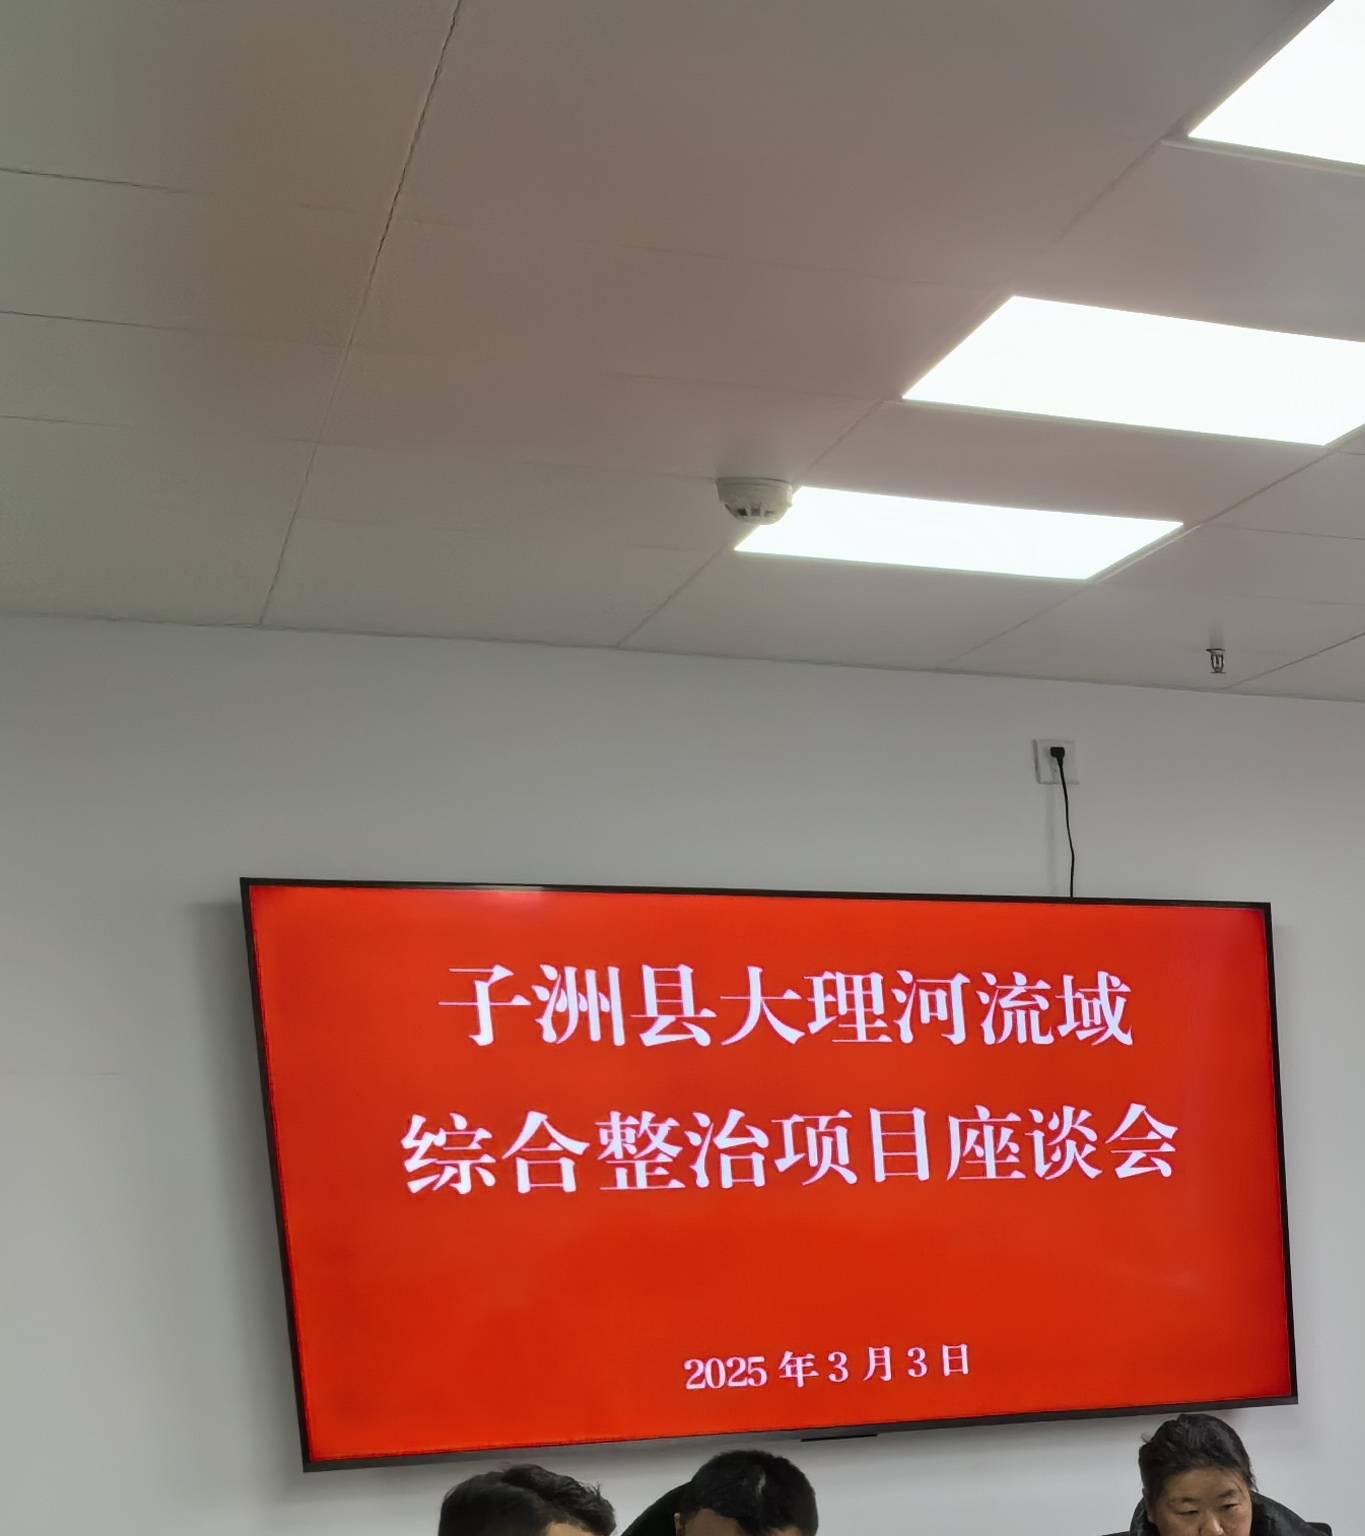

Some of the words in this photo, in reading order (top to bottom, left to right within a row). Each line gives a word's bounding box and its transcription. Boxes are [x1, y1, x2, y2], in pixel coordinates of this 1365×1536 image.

[438, 963, 1134, 1047] 子洲县大理河流域
[399, 1103, 1179, 1196] 综合整治项目座谈会
